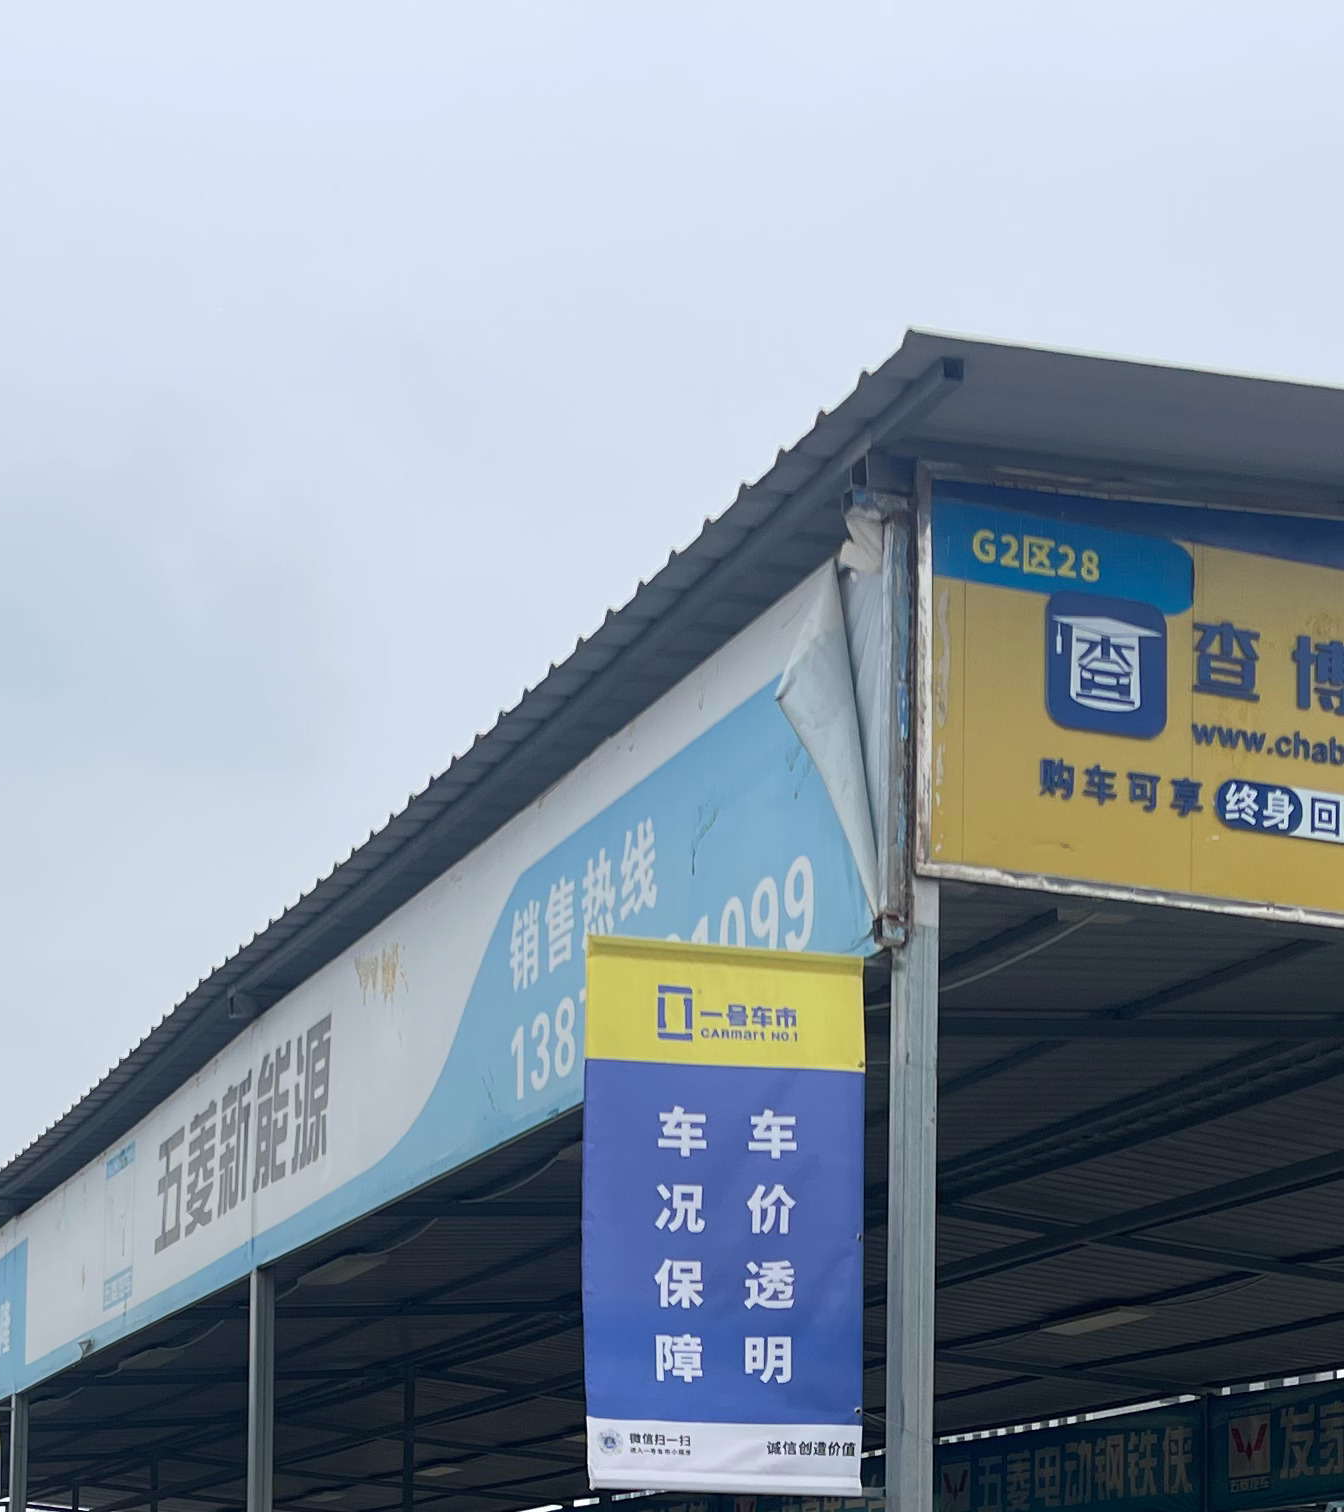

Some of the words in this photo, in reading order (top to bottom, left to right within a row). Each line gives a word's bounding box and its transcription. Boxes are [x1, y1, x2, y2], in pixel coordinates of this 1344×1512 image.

[972, 528, 1101, 583] G2区28
[1038, 757, 1204, 817] 购车可享
[1224, 783, 1297, 831] 终身
[509, 817, 658, 993] 销售热线
[700, 1003, 798, 1029] 一号车市
[155, 1013, 333, 1255] 五菱新能源
[654, 1105, 708, 1383] 车况保障
[744, 1108, 798, 1385] 车价透明
[630, 1433, 691, 1447] 微信扫一扫
[767, 1441, 856, 1457] 诚信创造价值
